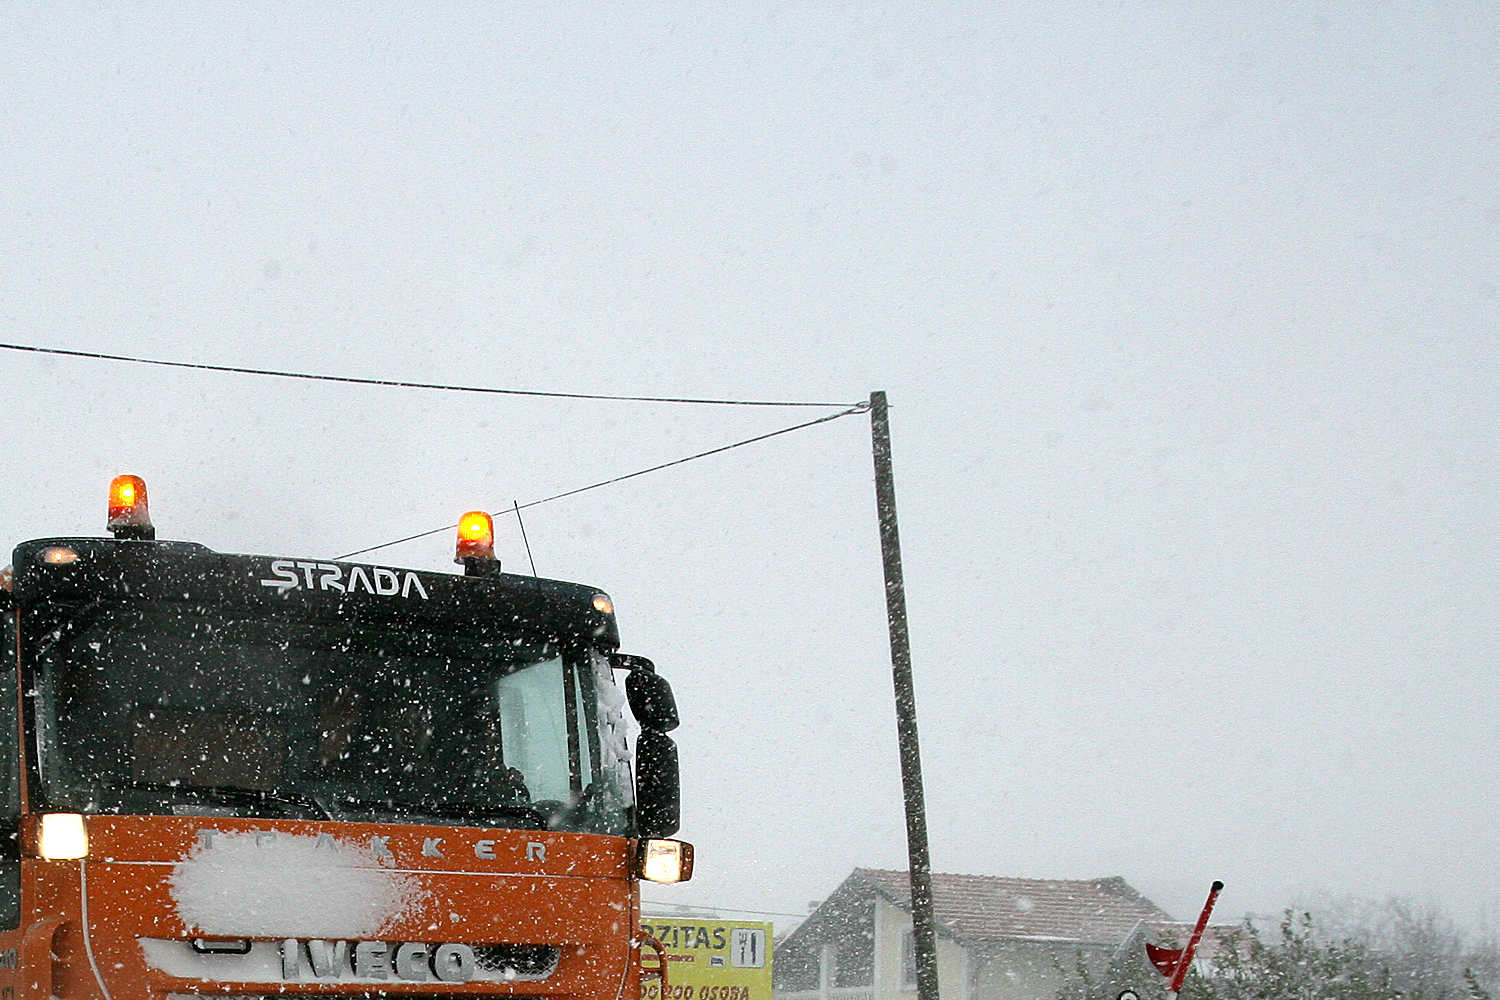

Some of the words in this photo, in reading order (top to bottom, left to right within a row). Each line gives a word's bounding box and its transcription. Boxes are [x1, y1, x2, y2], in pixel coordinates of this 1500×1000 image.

[260, 559, 429, 601] STRADA
[279, 938, 475, 983] IVECO
[699, 985, 750, 1000] OSOBA
